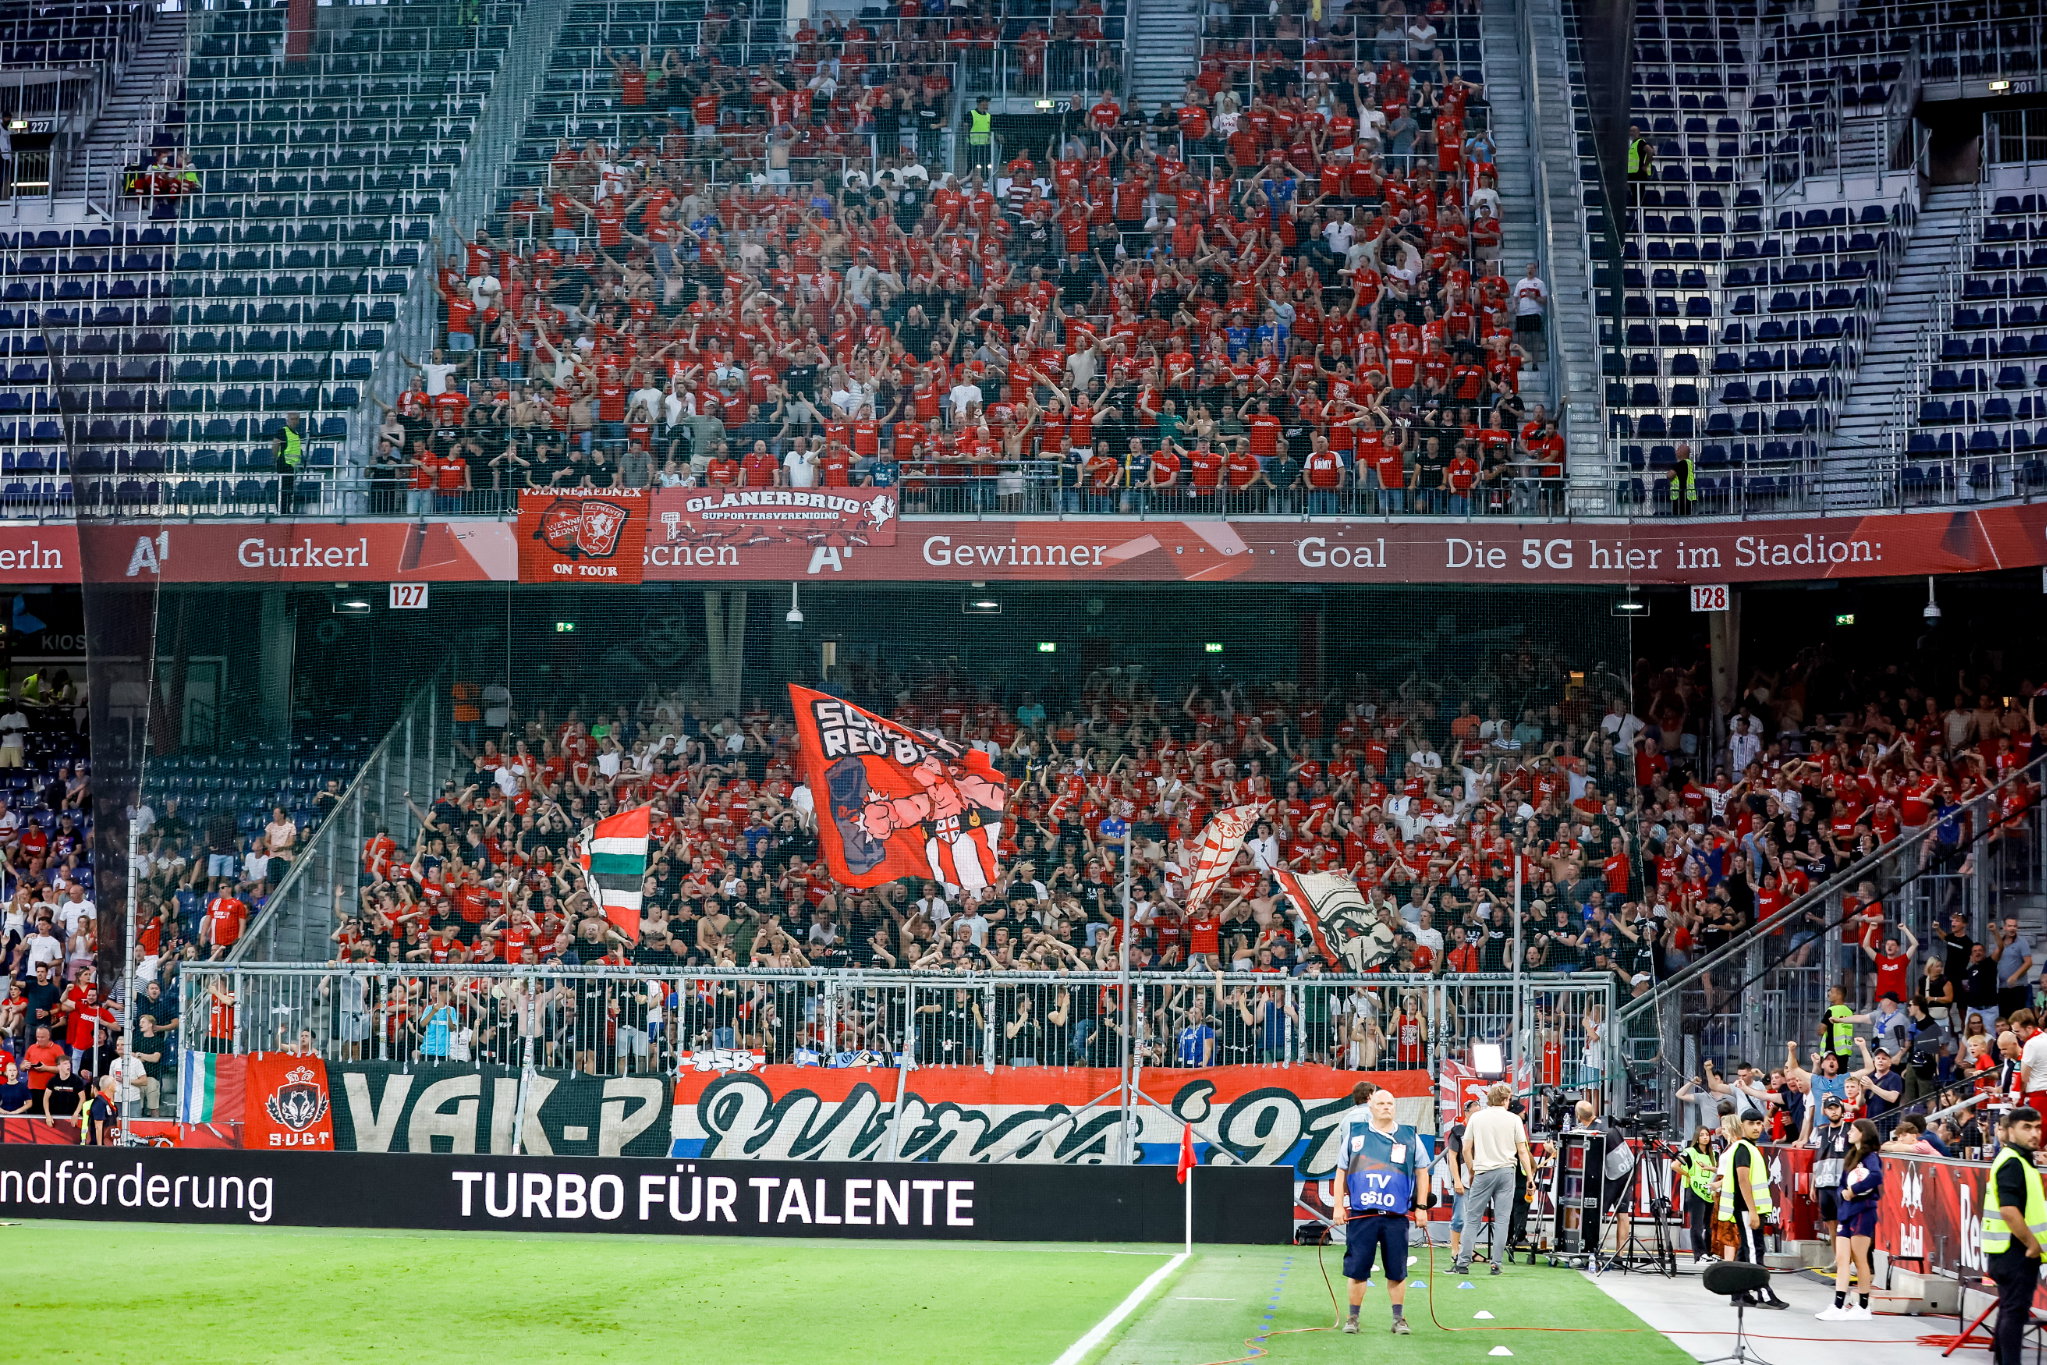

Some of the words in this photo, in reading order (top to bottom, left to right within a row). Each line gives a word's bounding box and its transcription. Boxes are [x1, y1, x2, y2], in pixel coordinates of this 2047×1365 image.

[2013, 81, 2033, 94] 201
[31, 121, 50, 133] 227
[1313, 458, 1332, 470] ARMY
[686, 491, 860, 513] GLANERBRUG
[238, 538, 370, 569] Gurkerl
[923, 535, 1102, 567] Gewinner
[1297, 538, 1388, 569] Goal
[1446, 538, 1508, 570] Die
[1521, 539, 1575, 570] 5G
[1588, 539, 1664, 571] hier
[1677, 541, 1723, 570] im
[1735, 534, 1883, 568] Stadion:
[552, 564, 573, 575] ON
[578, 565, 619, 577] TOUR
[391, 586, 425, 607] 127
[1693, 588, 1727, 610] 128
[690, 1049, 755, 1072] TSB
[0, 1159, 274, 1222] ndförderung
[1366, 1173, 1392, 1189] TV
[452, 1171, 624, 1221] TURBO
[639, 1163, 738, 1224] FÜR
[749, 1177, 976, 1228] TALENTE
[1360, 1191, 1395, 1207] 9610
